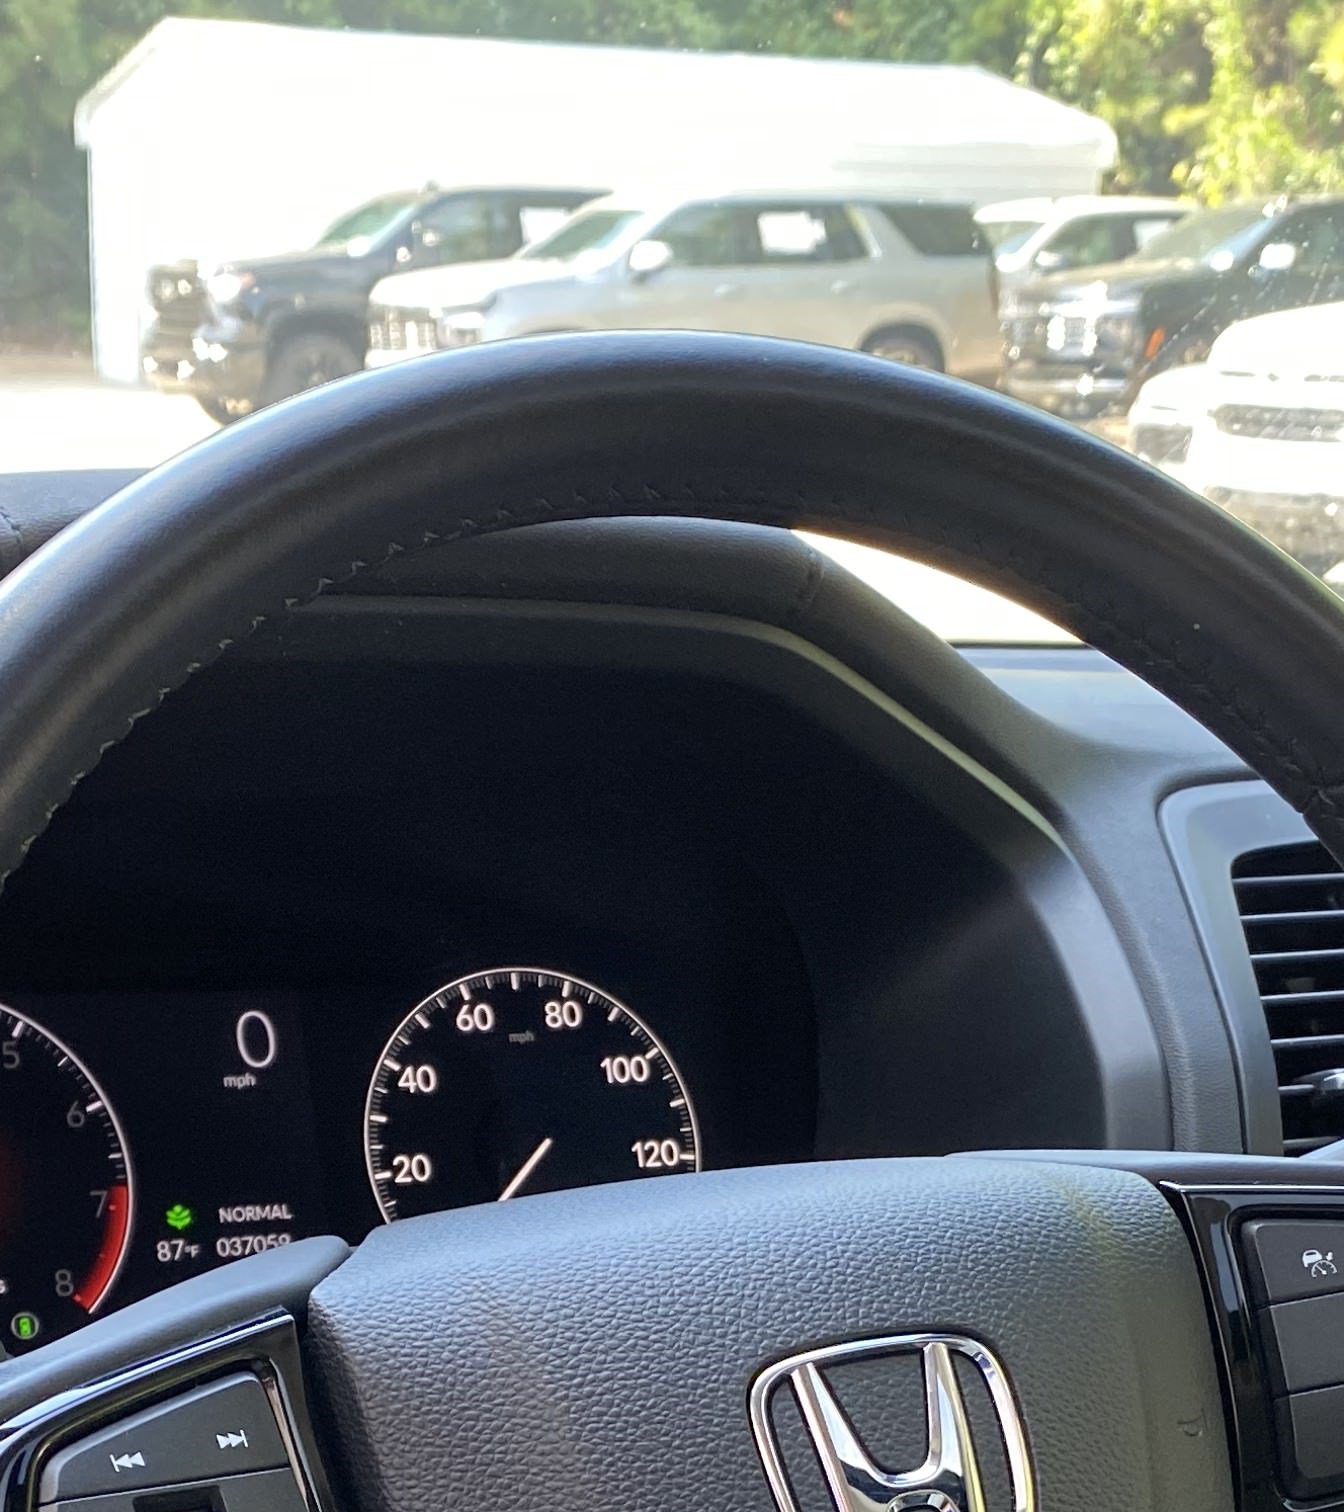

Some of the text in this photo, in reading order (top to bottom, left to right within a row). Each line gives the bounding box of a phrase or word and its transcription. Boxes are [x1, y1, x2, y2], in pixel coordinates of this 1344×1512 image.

[456, 1003, 495, 1032] 60
[544, 1001, 583, 1029] 80
[236, 1010, 277, 1068] 0
[509, 1030, 535, 1046] mph
[3, 1043, 21, 1069] 5
[601, 1056, 649, 1084] 100
[223, 1073, 256, 1089] mph
[398, 1065, 438, 1094] 40
[67, 1102, 85, 1128] 6
[393, 1154, 431, 1183] 20
[631, 1141, 680, 1168] 120
[90, 1190, 108, 1219] 7
[218, 1204, 294, 1223] NORMAL
[56, 1269, 74, 1297] 8
